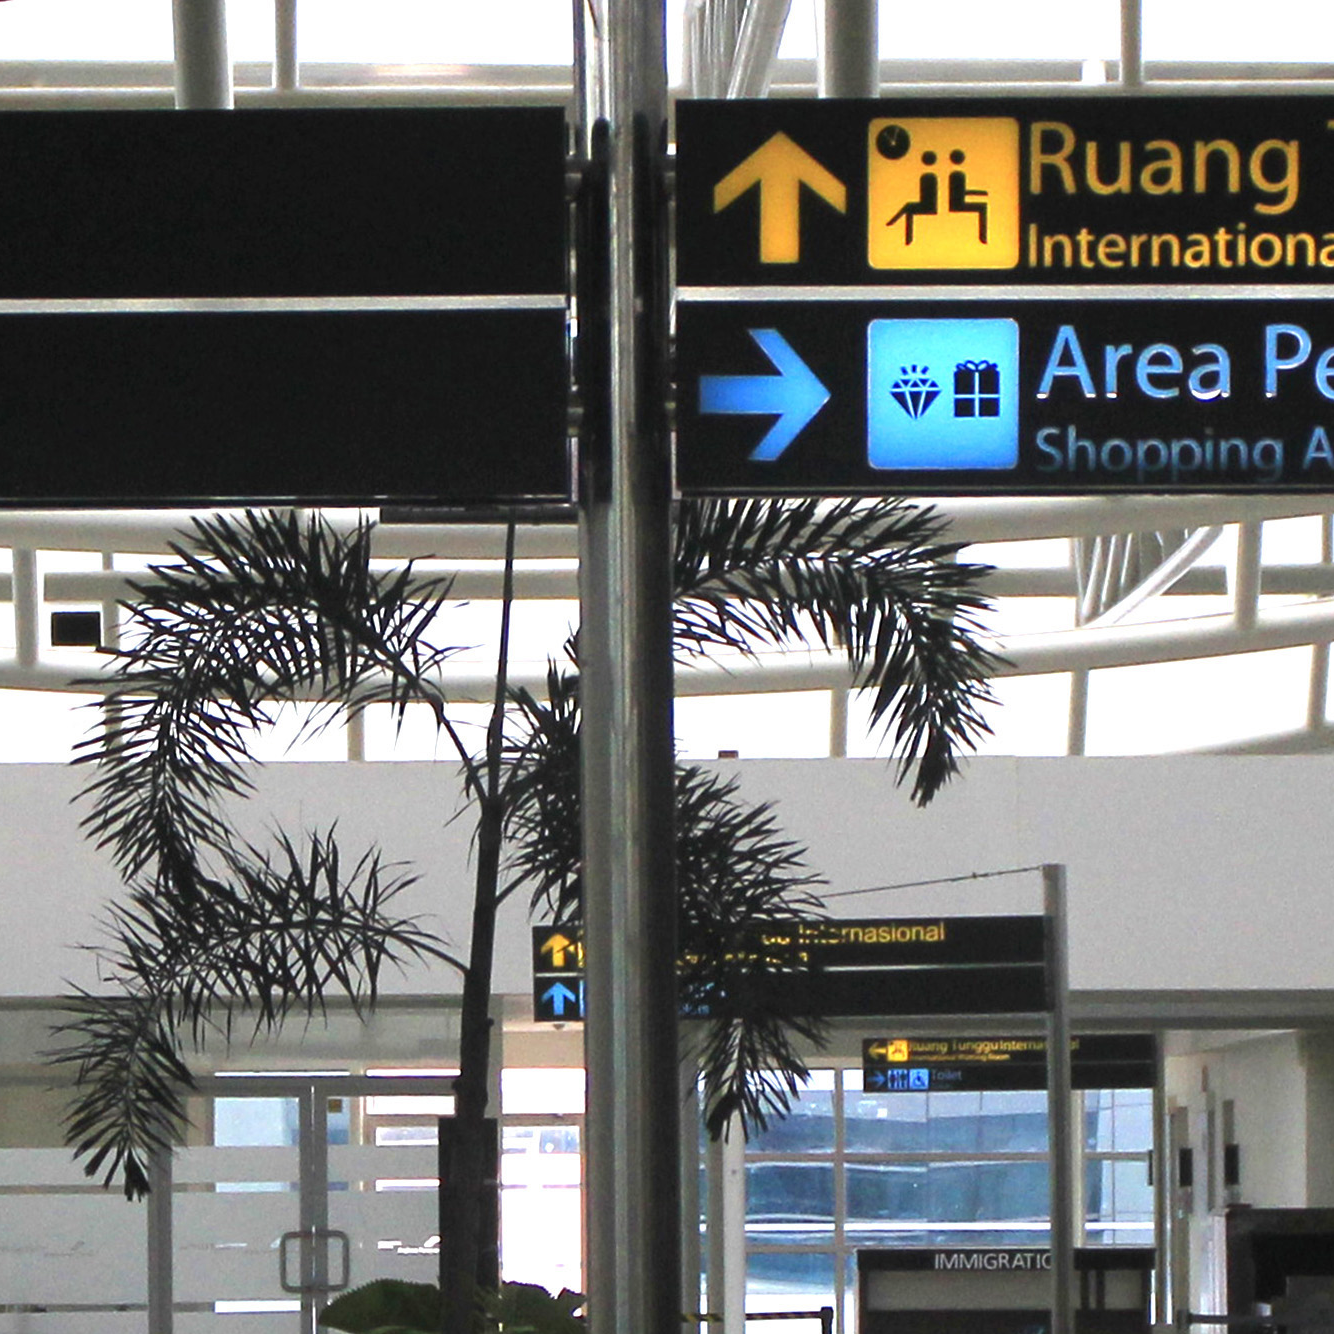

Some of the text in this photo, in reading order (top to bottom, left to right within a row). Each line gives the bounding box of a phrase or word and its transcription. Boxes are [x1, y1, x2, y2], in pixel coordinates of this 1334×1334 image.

[1030, 122, 1299, 214] Ruang
[1035, 325, 1231, 400] Area
[1034, 425, 1284, 482] Shopping
